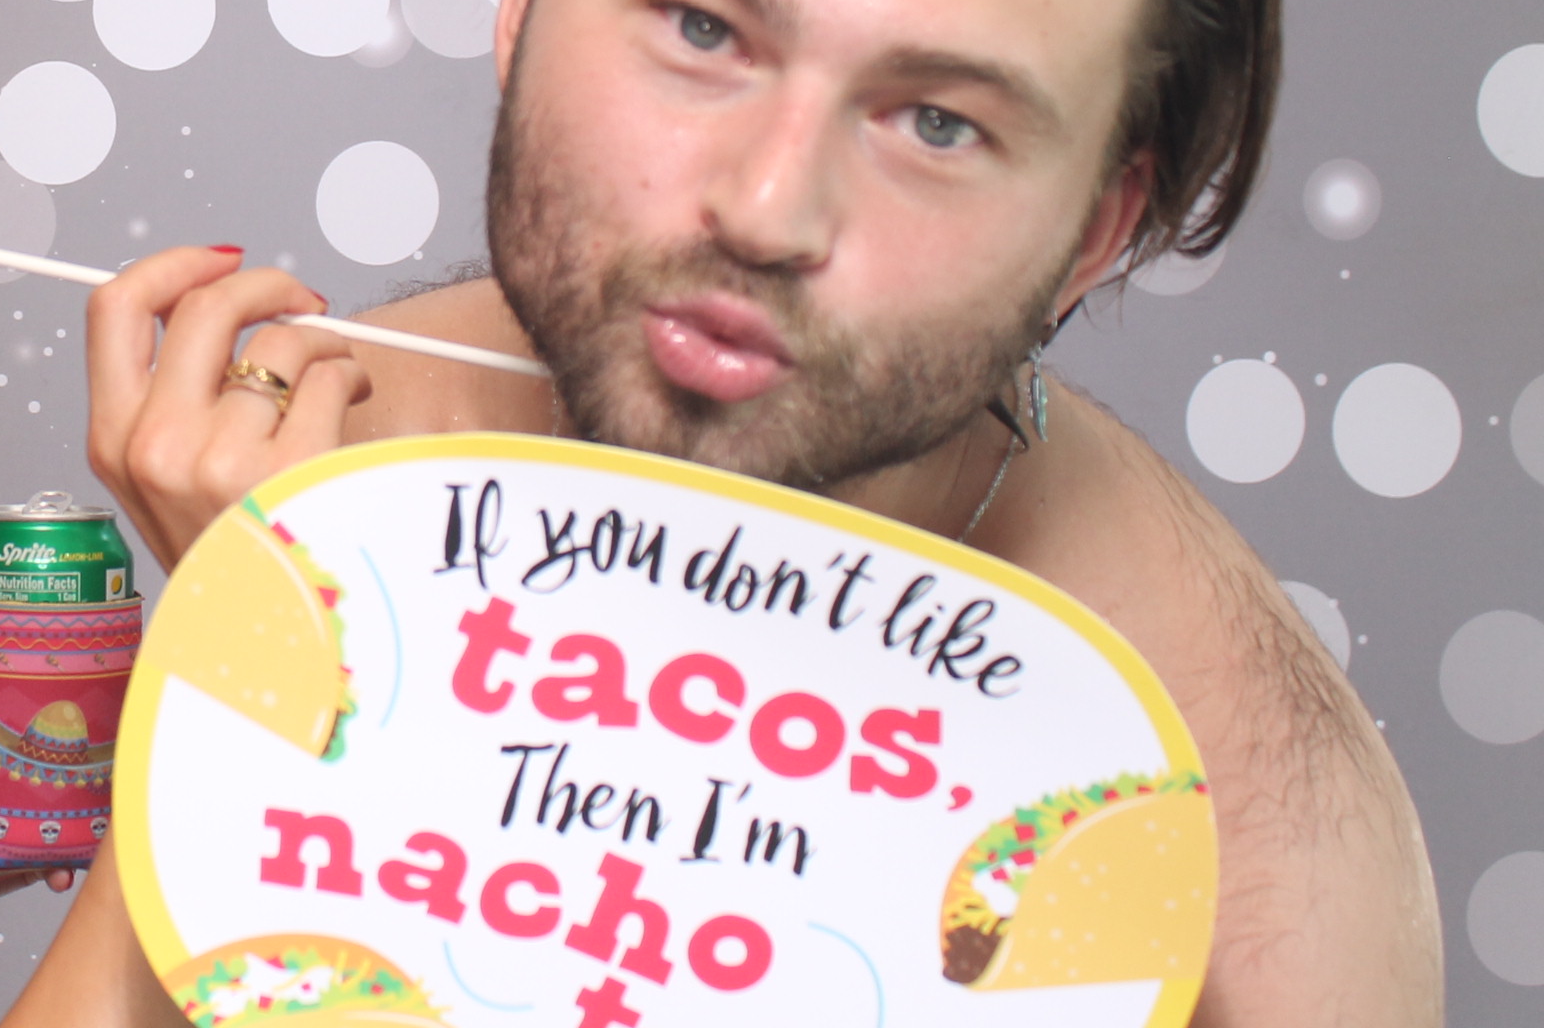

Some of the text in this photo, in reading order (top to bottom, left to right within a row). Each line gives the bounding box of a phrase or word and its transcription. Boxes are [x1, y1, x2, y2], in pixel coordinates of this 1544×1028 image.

[0, 576, 77, 590] Nutrition Facts
[432, 479, 1028, 698] If you don't like
[451, 596, 974, 811] tacos,
[259, 807, 774, 991] nacho
[500, 743, 818, 878] Then I'm
